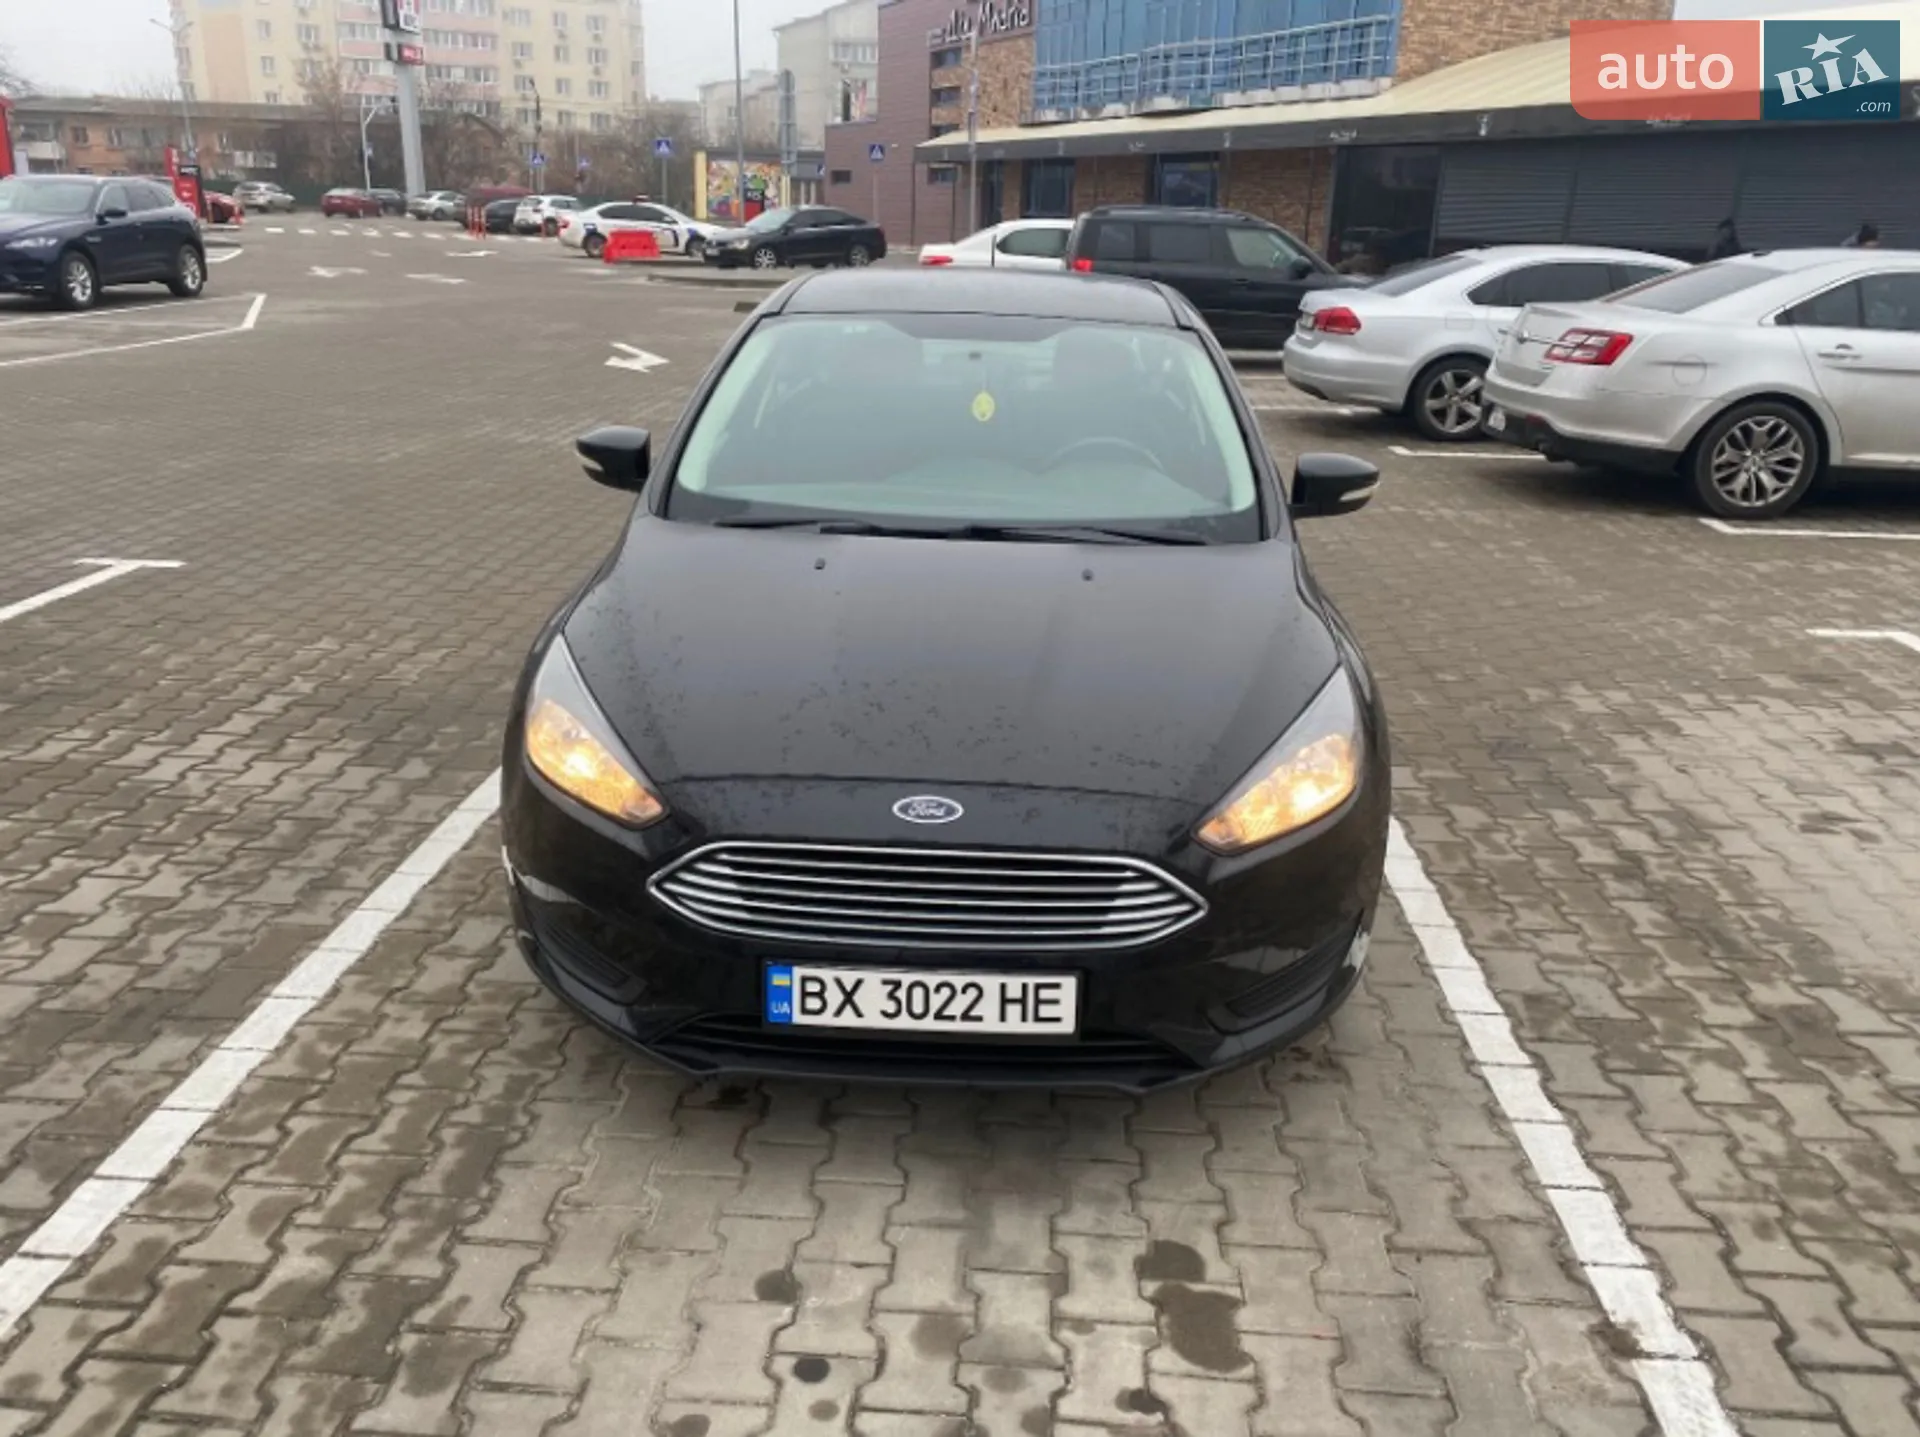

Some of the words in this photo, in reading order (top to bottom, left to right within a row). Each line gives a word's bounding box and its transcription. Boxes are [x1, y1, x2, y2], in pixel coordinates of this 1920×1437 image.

[907, 801, 947, 817] Ford
[799, 974, 865, 1018] BX
[879, 979, 985, 1023] 3022
[999, 981, 1063, 1023] HE
[771, 1001, 791, 1014] UA
